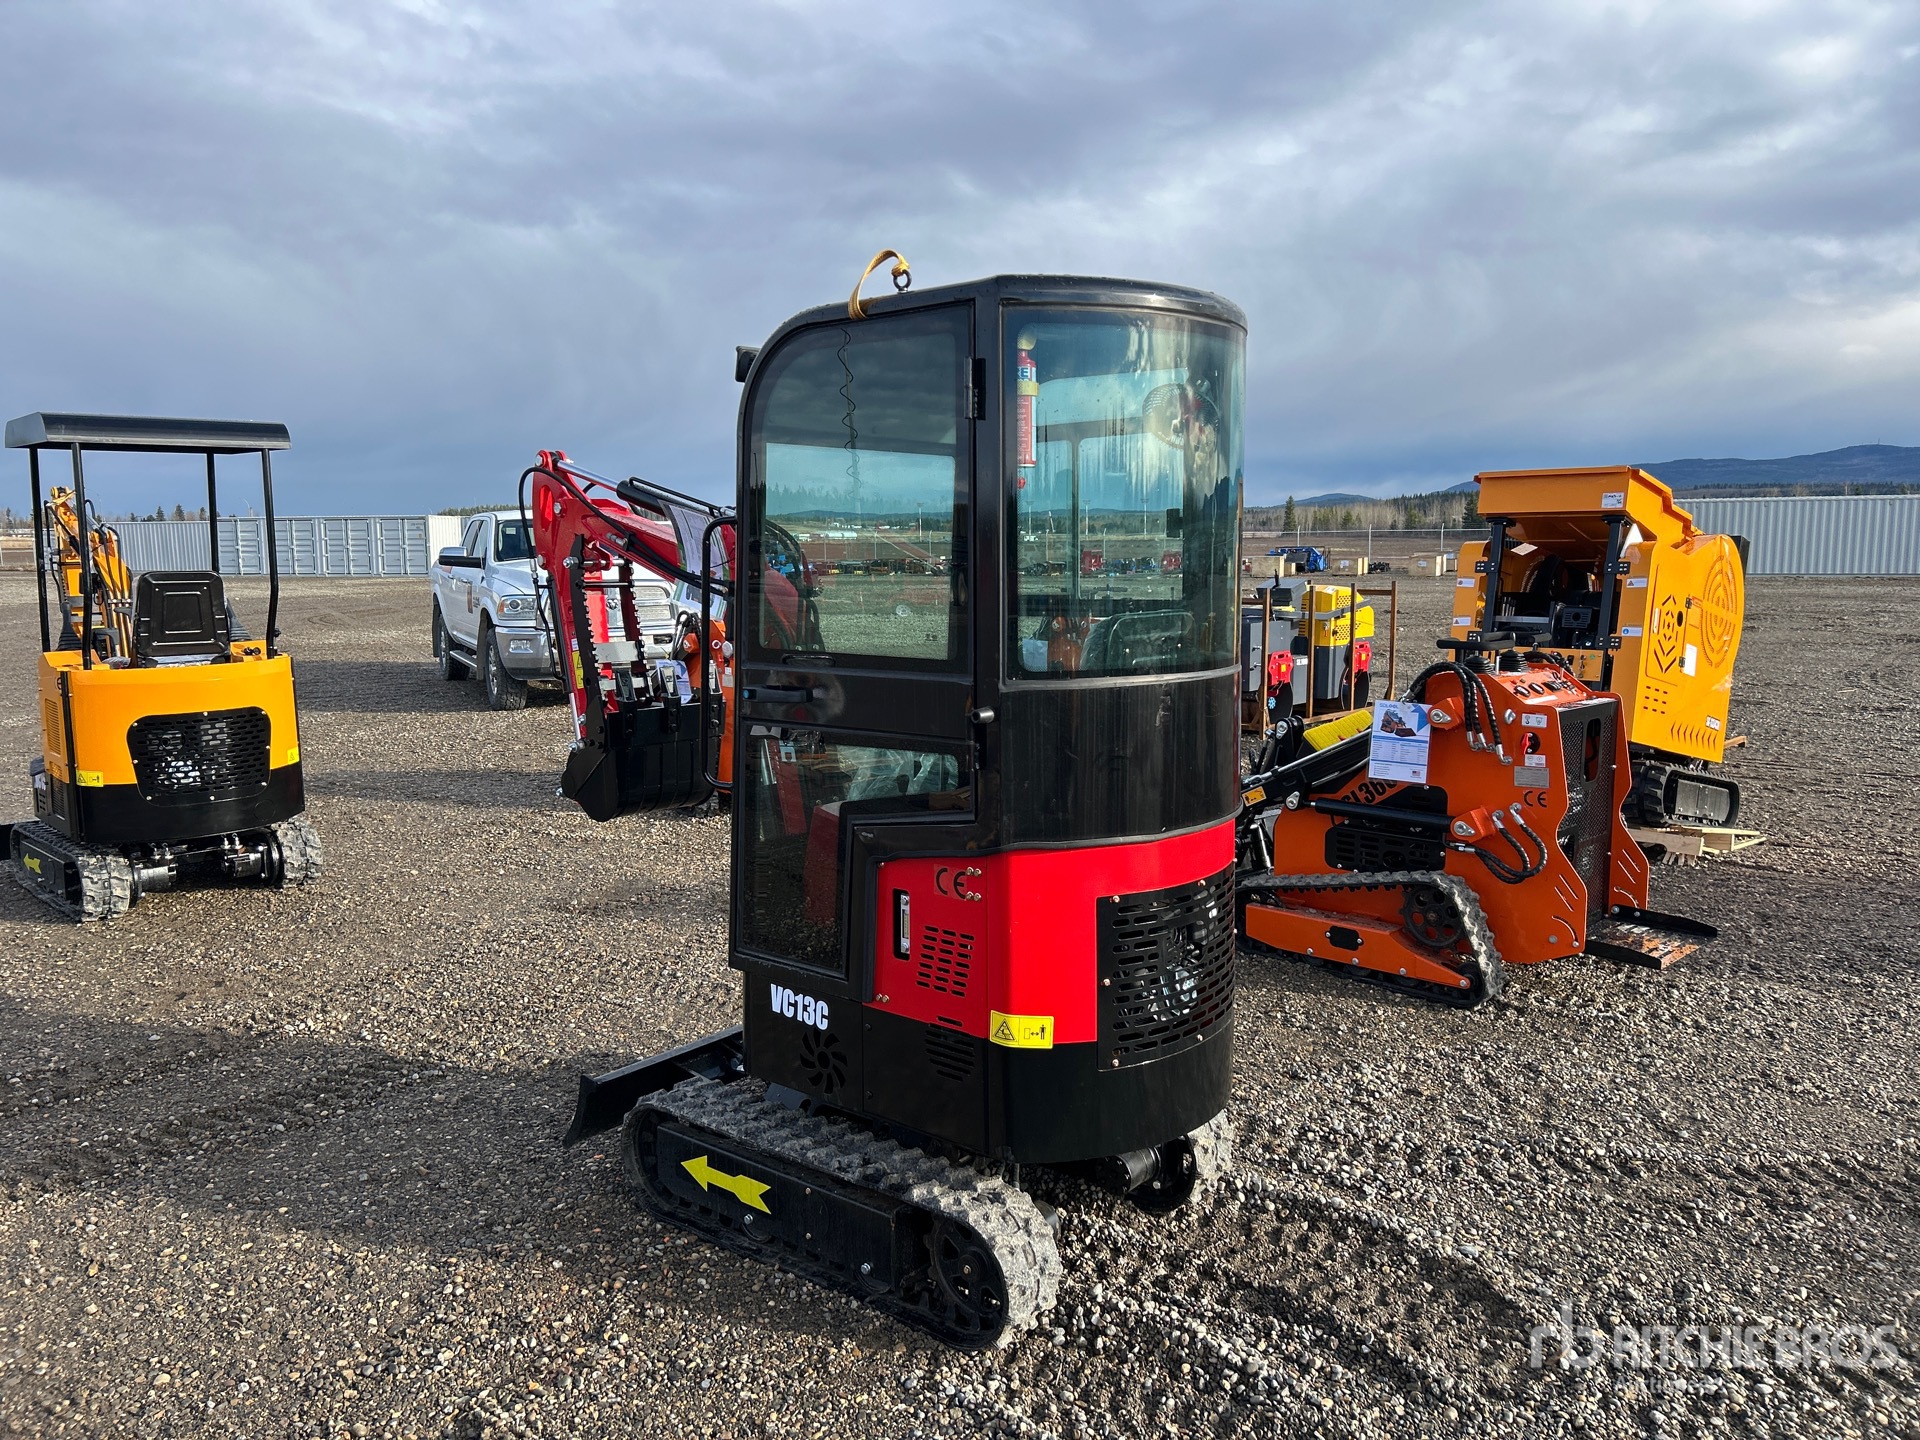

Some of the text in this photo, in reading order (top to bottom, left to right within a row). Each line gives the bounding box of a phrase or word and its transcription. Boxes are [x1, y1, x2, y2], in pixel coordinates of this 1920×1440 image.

[1523, 790, 1548, 808] CE
[935, 867, 967, 900] CE
[770, 983, 829, 1030] VC13C
